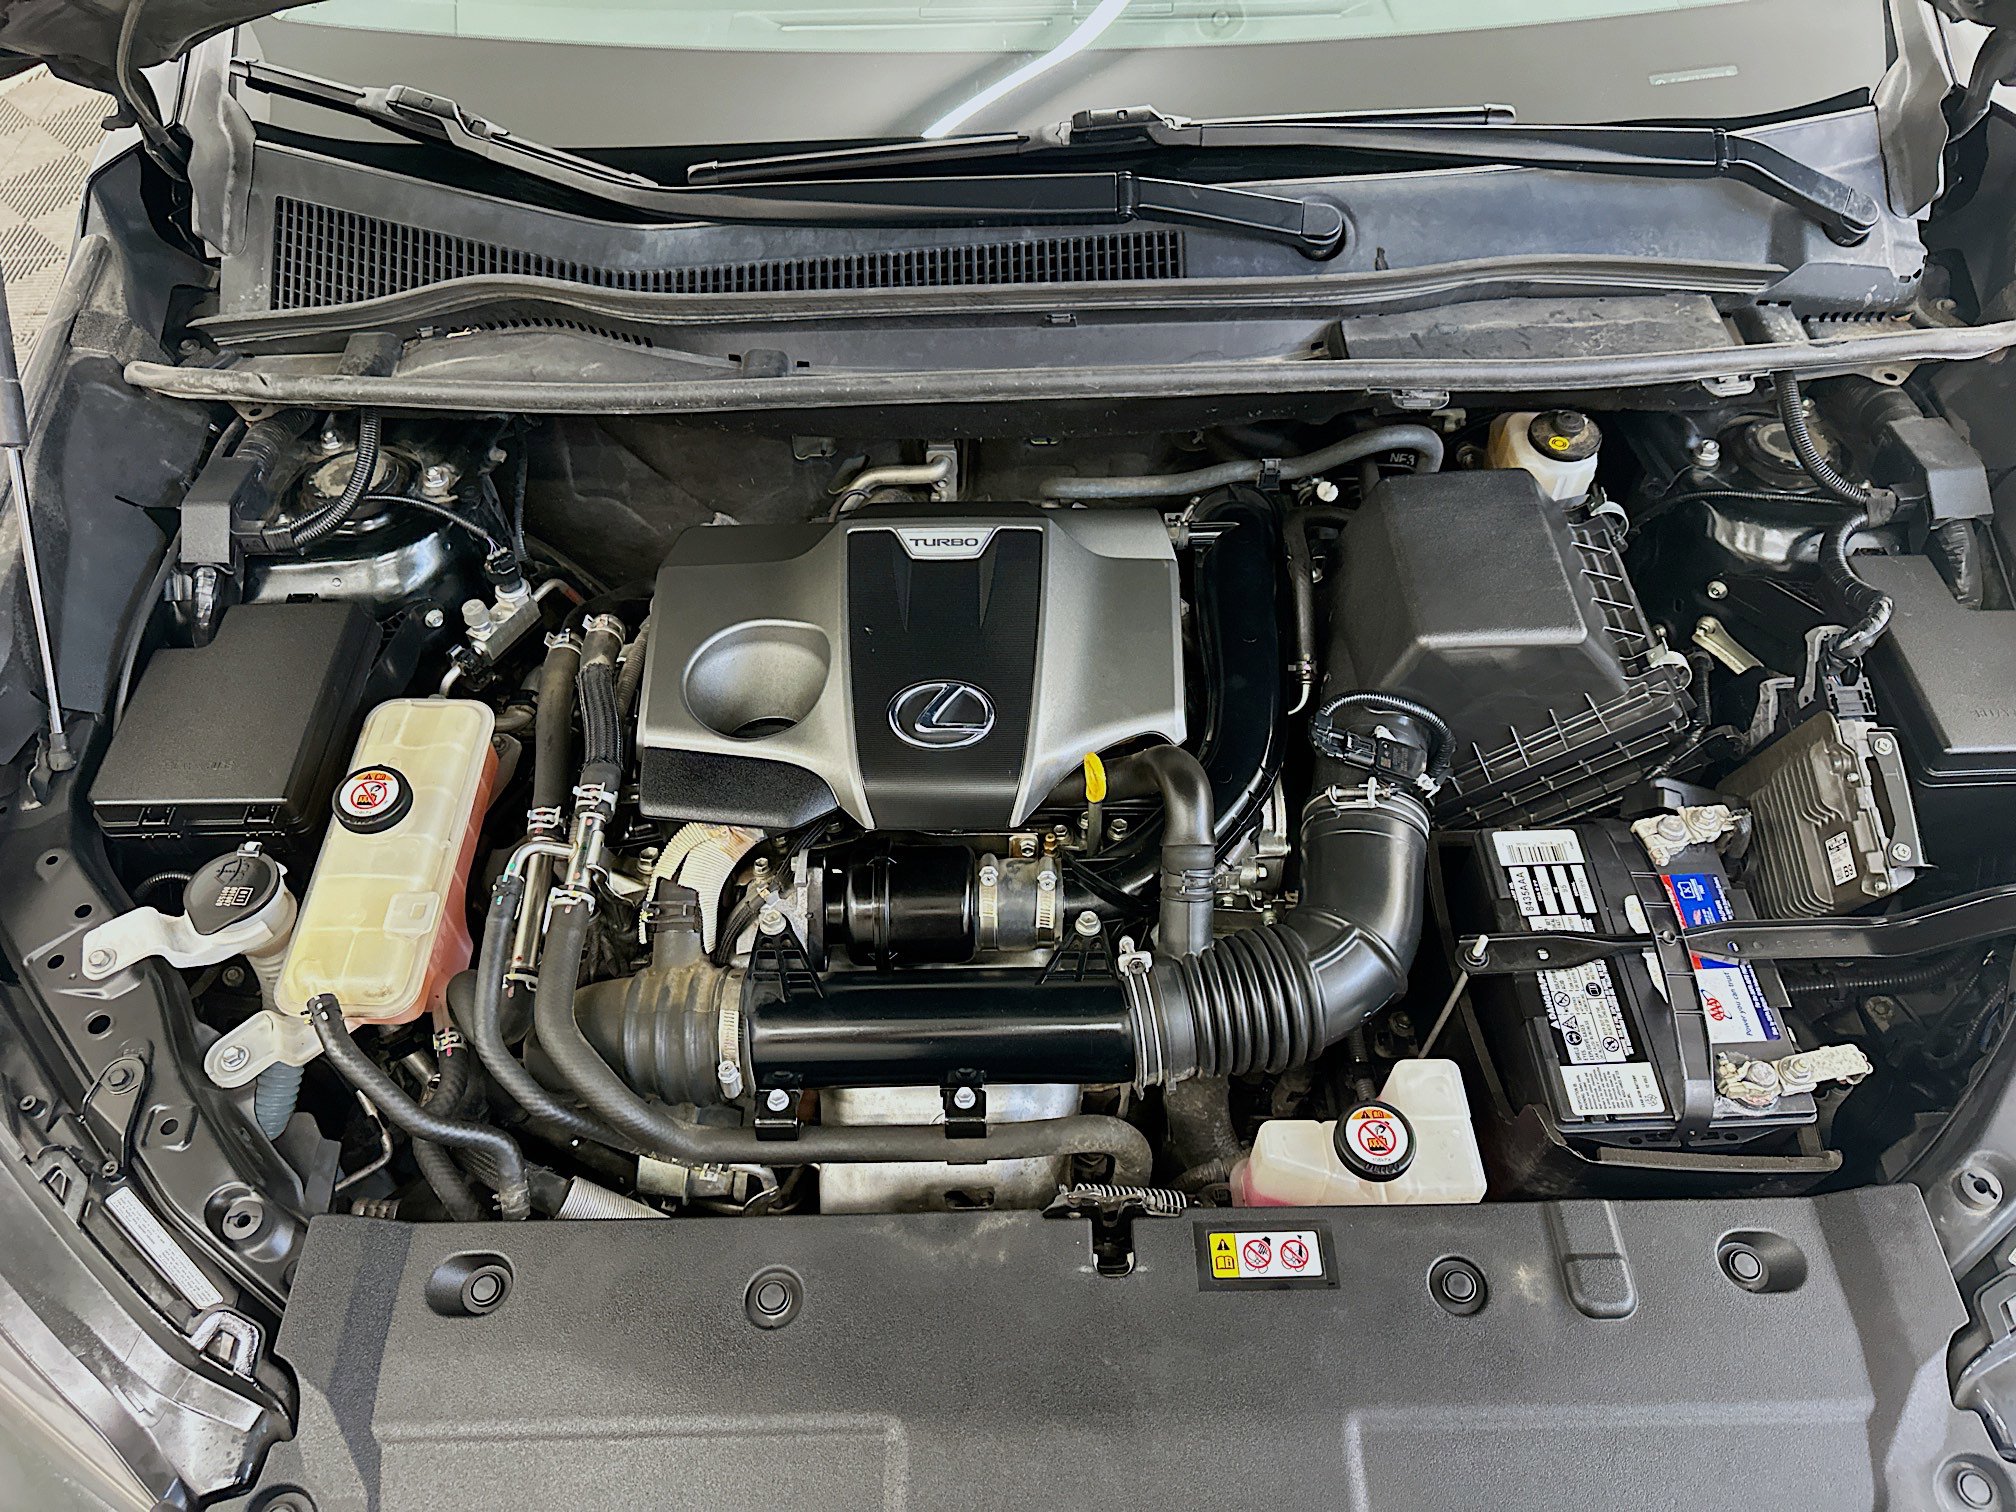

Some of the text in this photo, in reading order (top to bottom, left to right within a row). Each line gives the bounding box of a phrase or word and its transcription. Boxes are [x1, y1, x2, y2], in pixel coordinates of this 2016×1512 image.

[909, 538, 979, 547] TURBO
[1516, 871, 1534, 911] 8435AAA
[1723, 972, 1733, 986] trust
[1735, 1001, 1746, 1013] you
[1739, 1014, 1753, 1036] Power
